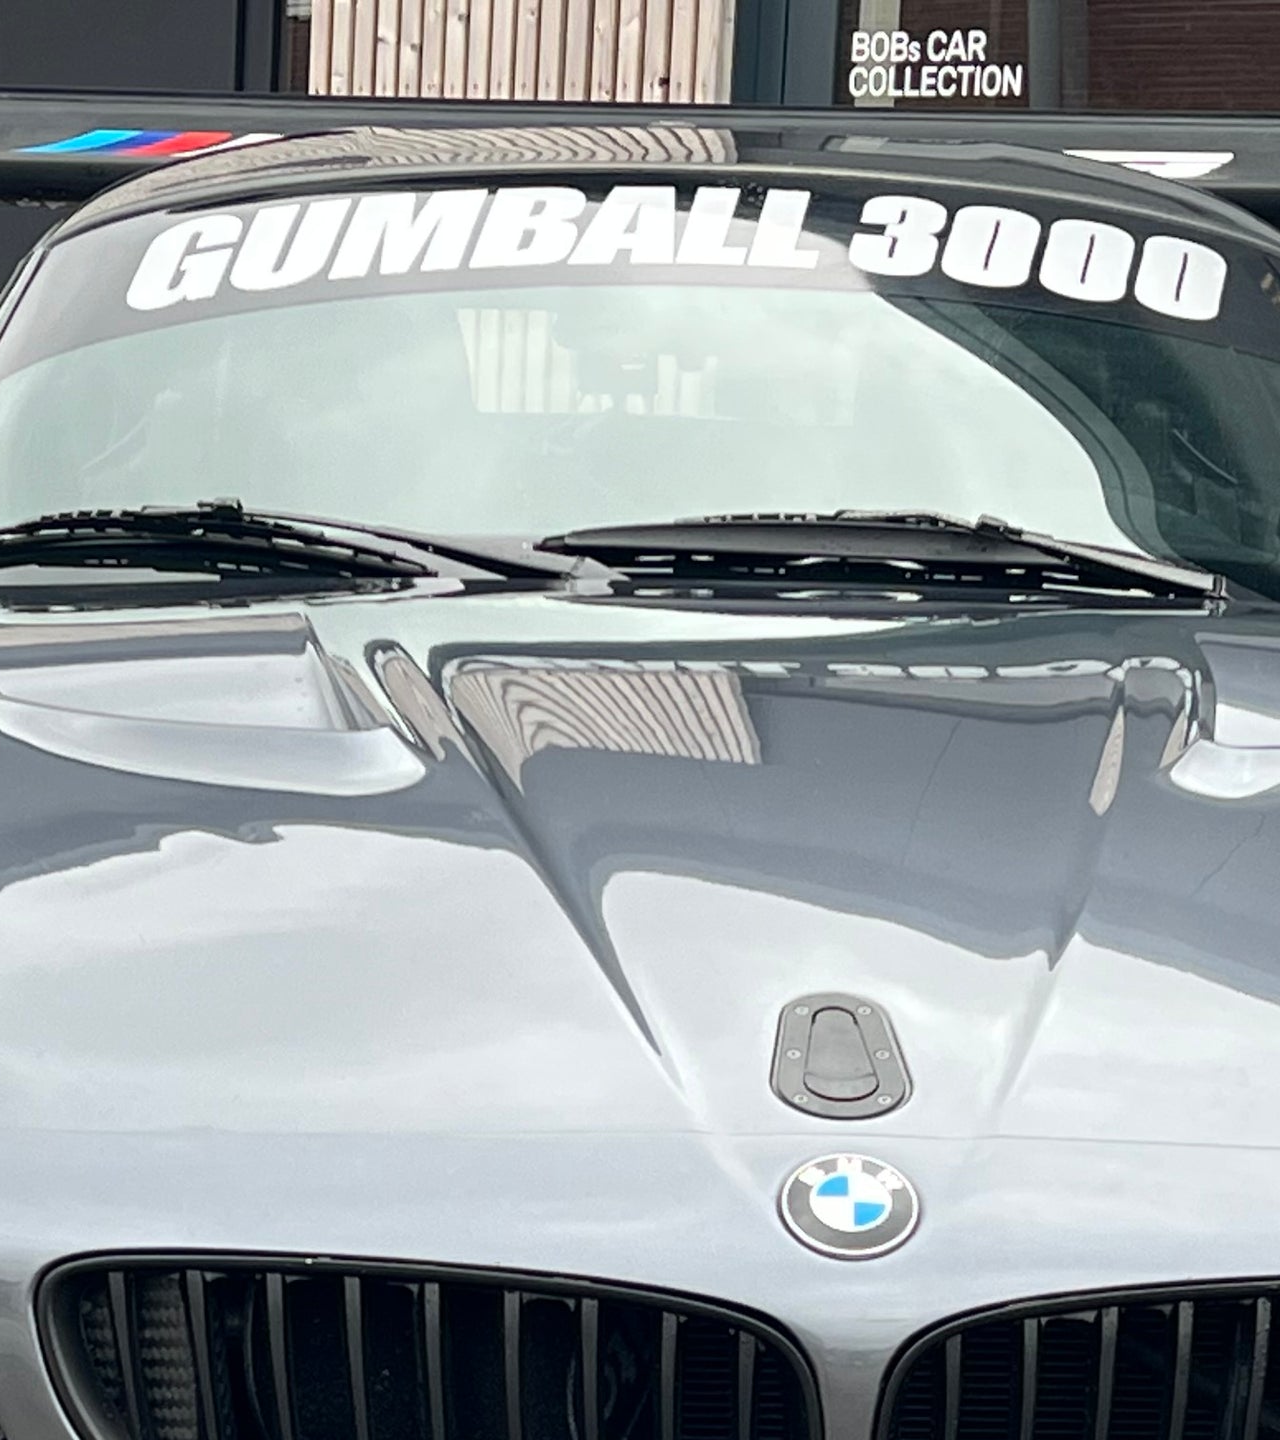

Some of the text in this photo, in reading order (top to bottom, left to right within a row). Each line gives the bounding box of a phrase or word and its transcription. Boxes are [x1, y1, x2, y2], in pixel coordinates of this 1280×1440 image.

[851, 29, 988, 63] BOBs CAR
[848, 64, 1023, 98] COLLECTION
[125, 185, 1228, 322] GUMBALL 3000
[798, 1155, 905, 1191] BMW
